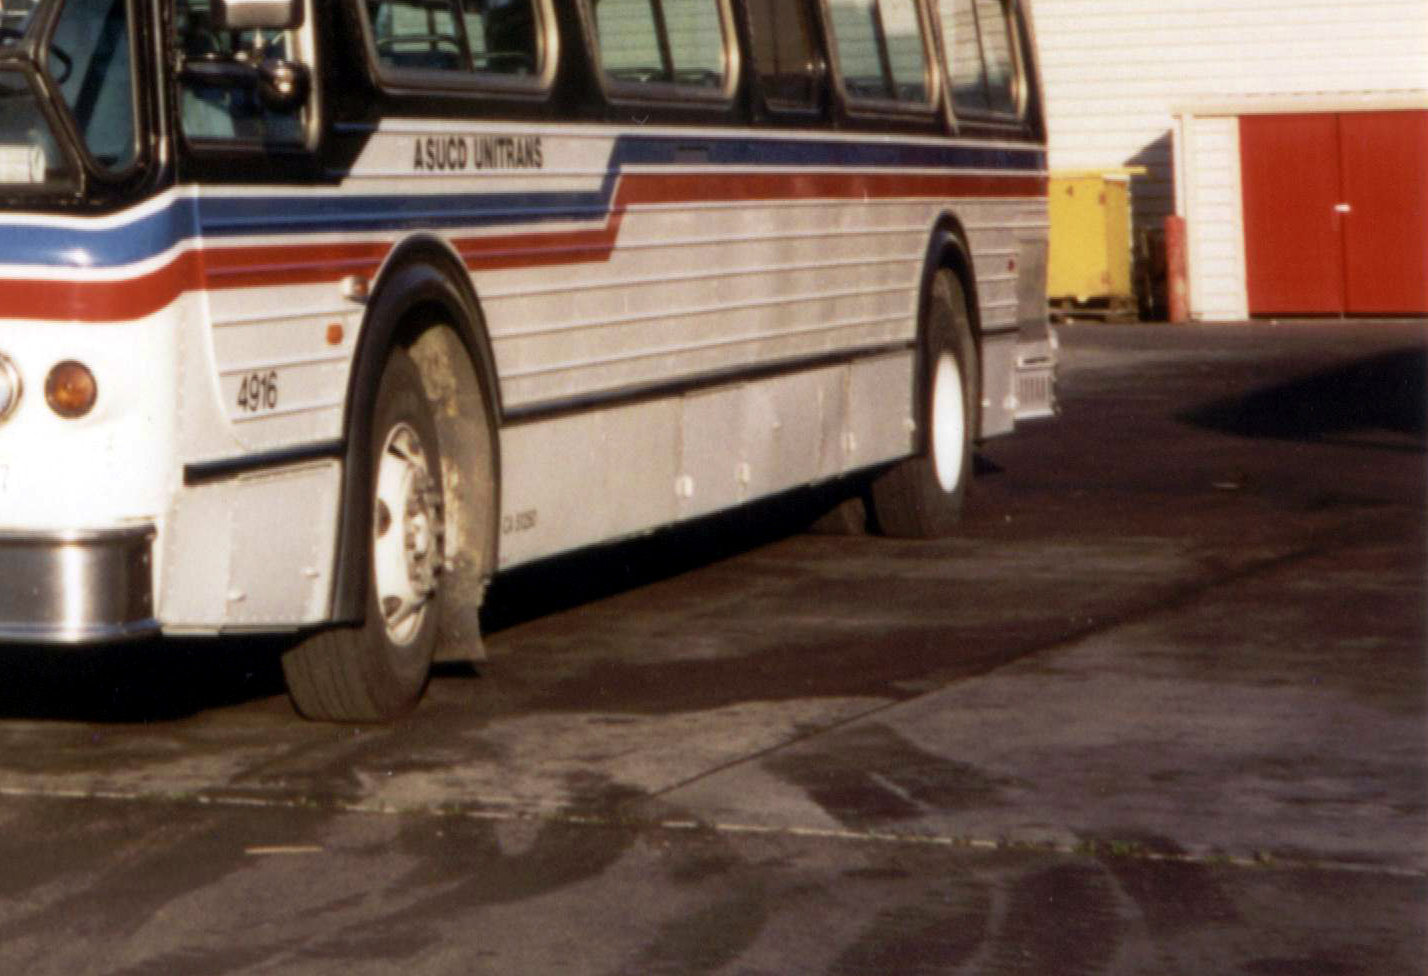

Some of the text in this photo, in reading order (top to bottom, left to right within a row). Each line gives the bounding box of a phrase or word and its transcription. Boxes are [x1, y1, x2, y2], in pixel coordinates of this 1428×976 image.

[413, 133, 544, 171] ASUCD UNITRANS
[236, 369, 278, 412] 4916
